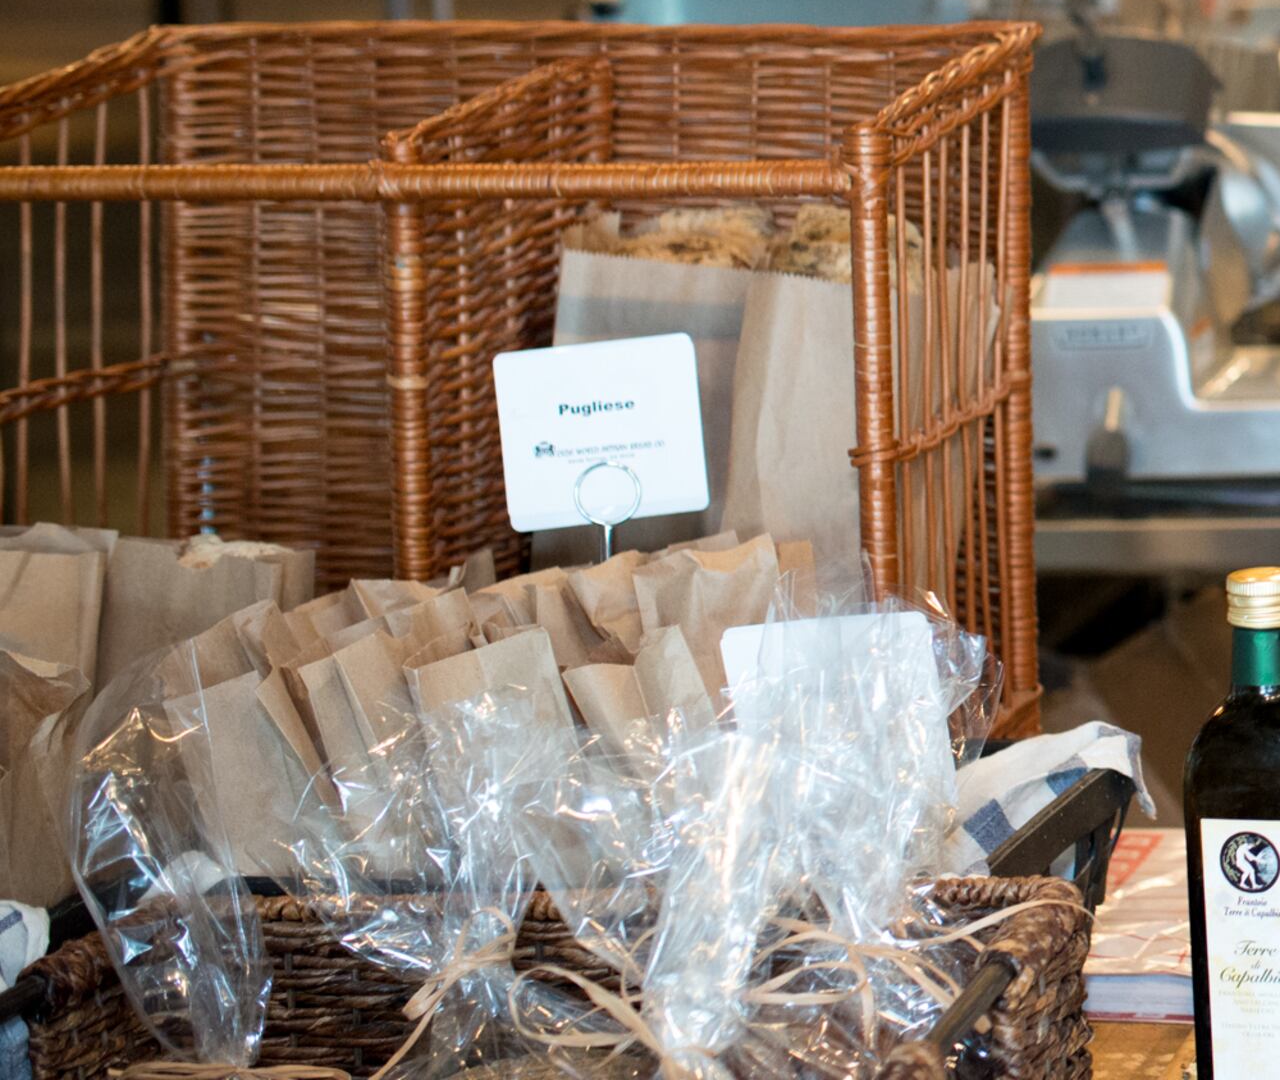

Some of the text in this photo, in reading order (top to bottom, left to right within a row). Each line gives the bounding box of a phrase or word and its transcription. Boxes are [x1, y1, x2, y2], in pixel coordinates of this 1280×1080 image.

[558, 399, 635, 417] Pugliese
[1224, 906, 1242, 916] Terre
[1234, 940, 1277, 956] Terre
